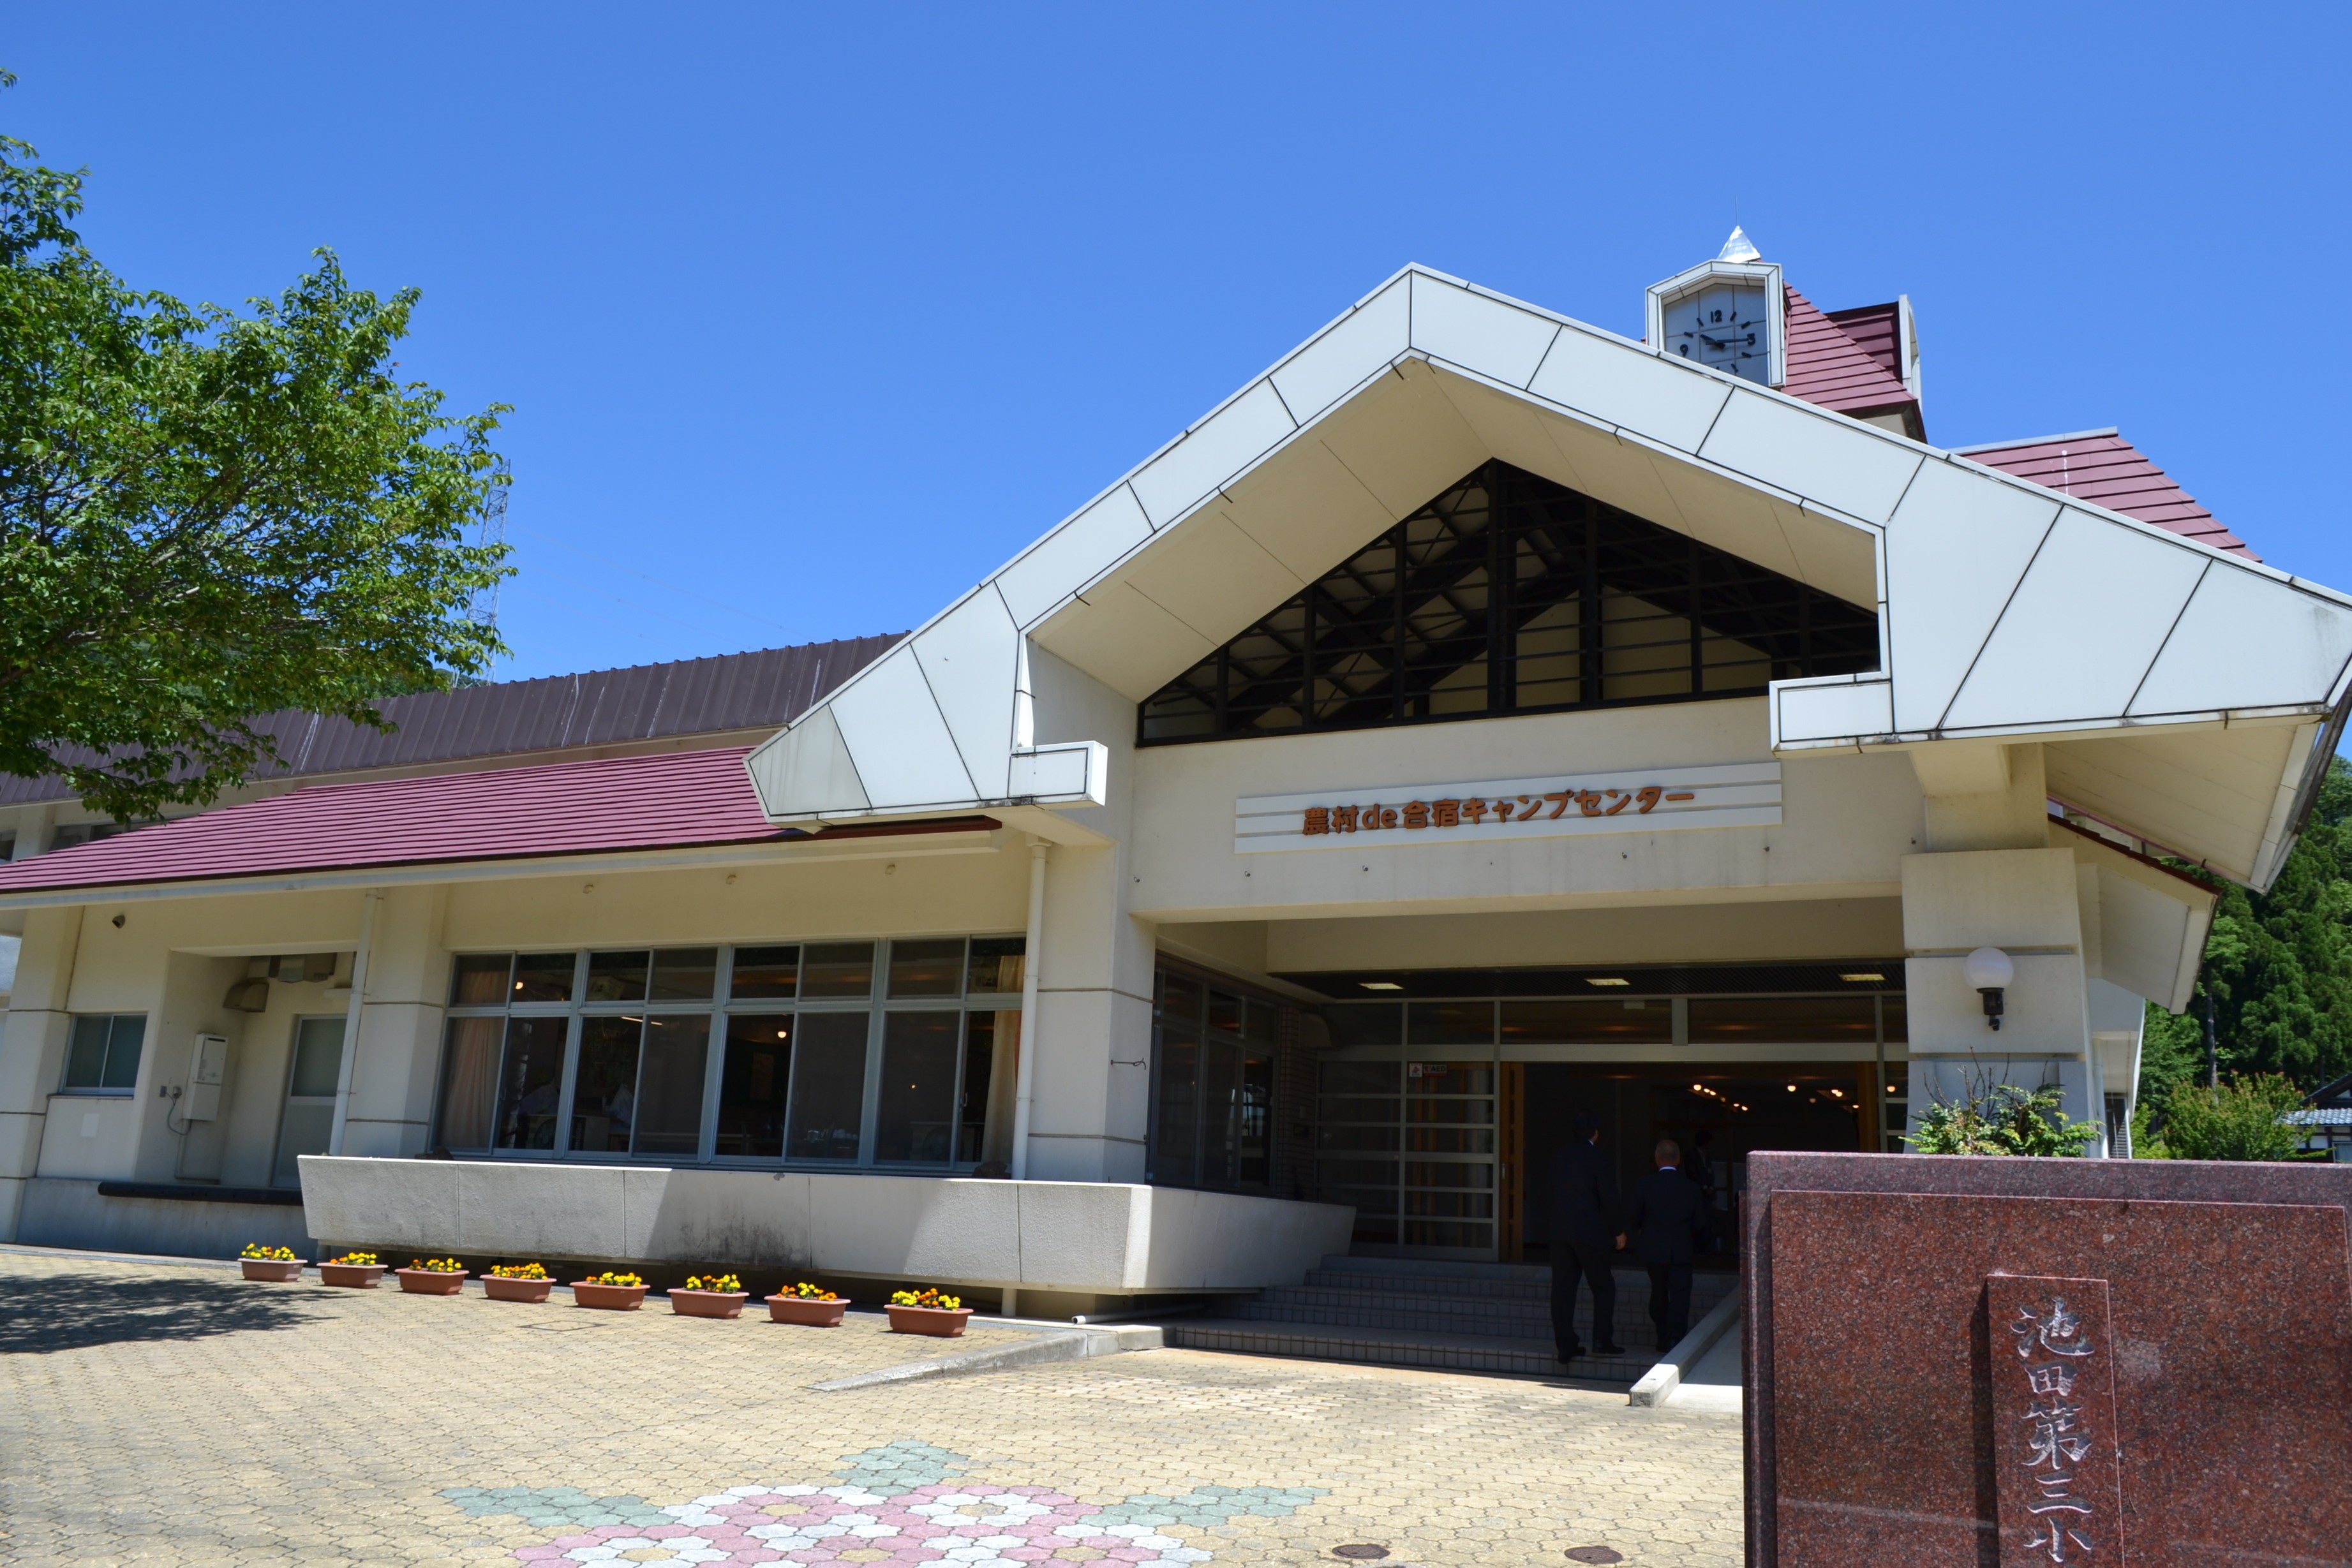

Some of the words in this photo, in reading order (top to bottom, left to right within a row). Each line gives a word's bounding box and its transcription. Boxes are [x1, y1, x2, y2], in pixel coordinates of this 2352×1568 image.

[1711, 310, 1722, 323] 12
[1747, 333, 1755, 346] 3
[1680, 344, 1688, 357] 9
[1302, 787, 1695, 835] 農村de合宿キャンプセンター
[2010, 1296, 2095, 1568] 池田第三小
